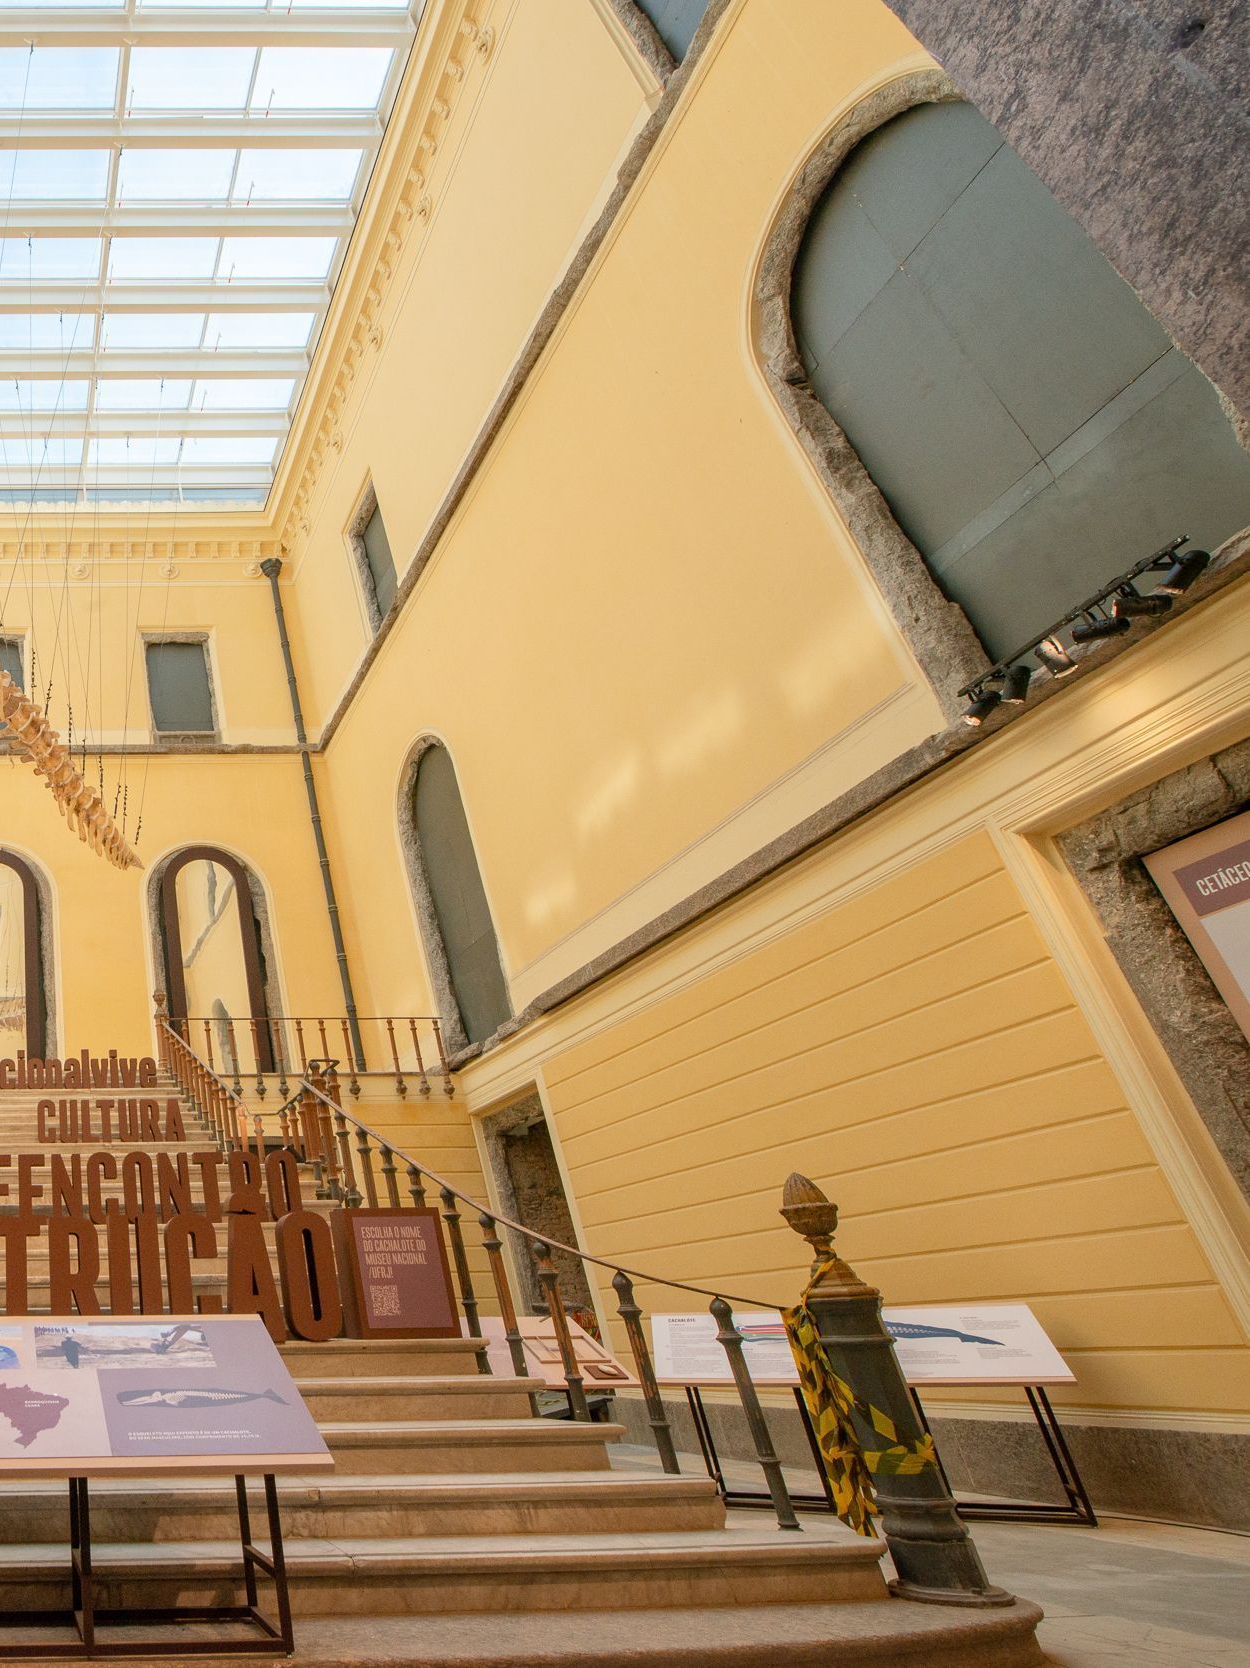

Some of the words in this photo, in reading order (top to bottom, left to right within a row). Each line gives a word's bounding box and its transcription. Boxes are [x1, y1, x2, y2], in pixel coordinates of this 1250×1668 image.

[37, 1099, 187, 1144] CULTURA
[361, 1226, 394, 1239] ESCOLHA
[394, 1226, 400, 1239] O
[400, 1226, 422, 1238] NOME
[362, 1240, 373, 1252] DO
[374, 1239, 415, 1252] CACHALOTE
[416, 1239, 427, 1251] DO
[365, 1252, 392, 1265] MUSEU
[392, 1252, 428, 1265] NACIONAL
